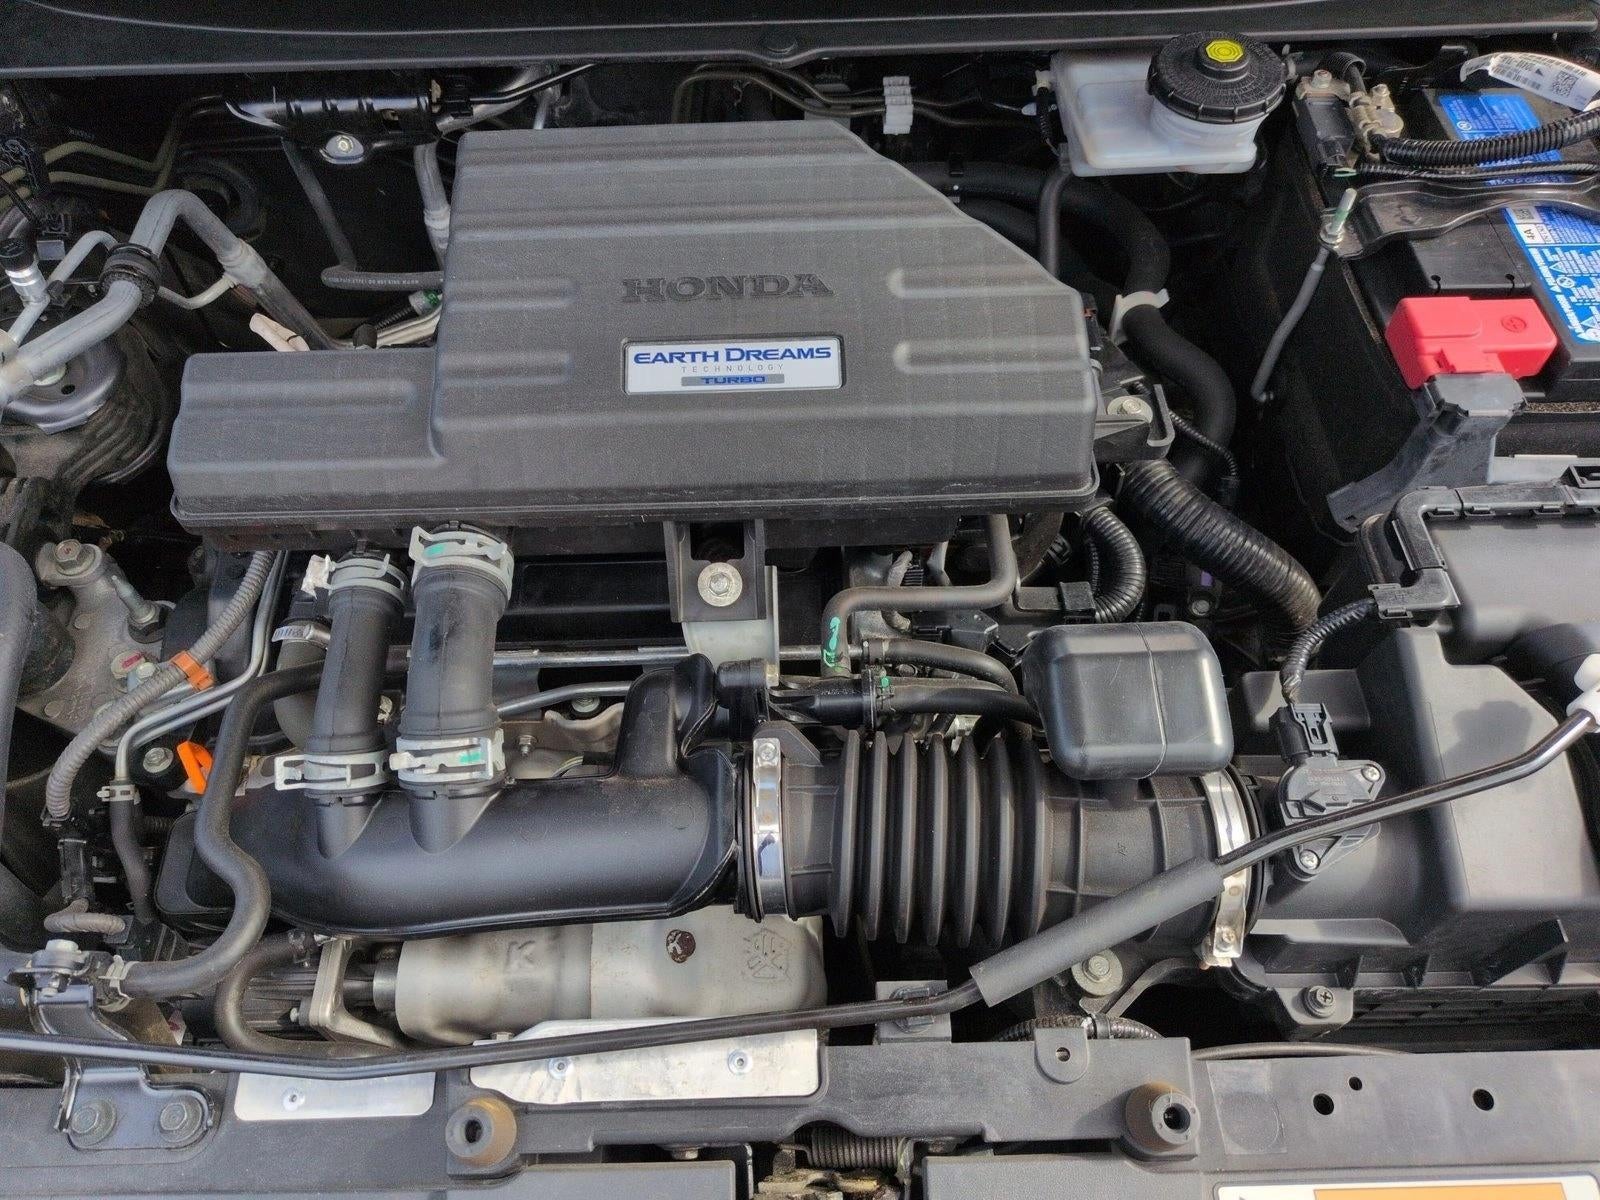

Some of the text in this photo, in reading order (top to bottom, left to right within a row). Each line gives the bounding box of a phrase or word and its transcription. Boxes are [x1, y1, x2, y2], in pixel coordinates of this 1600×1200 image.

[622, 273, 834, 302] HONDA
[633, 347, 831, 364] EARTH DREAMS
[682, 363, 784, 373] TECHNOLOGY
[702, 375, 766, 385] TURBO
